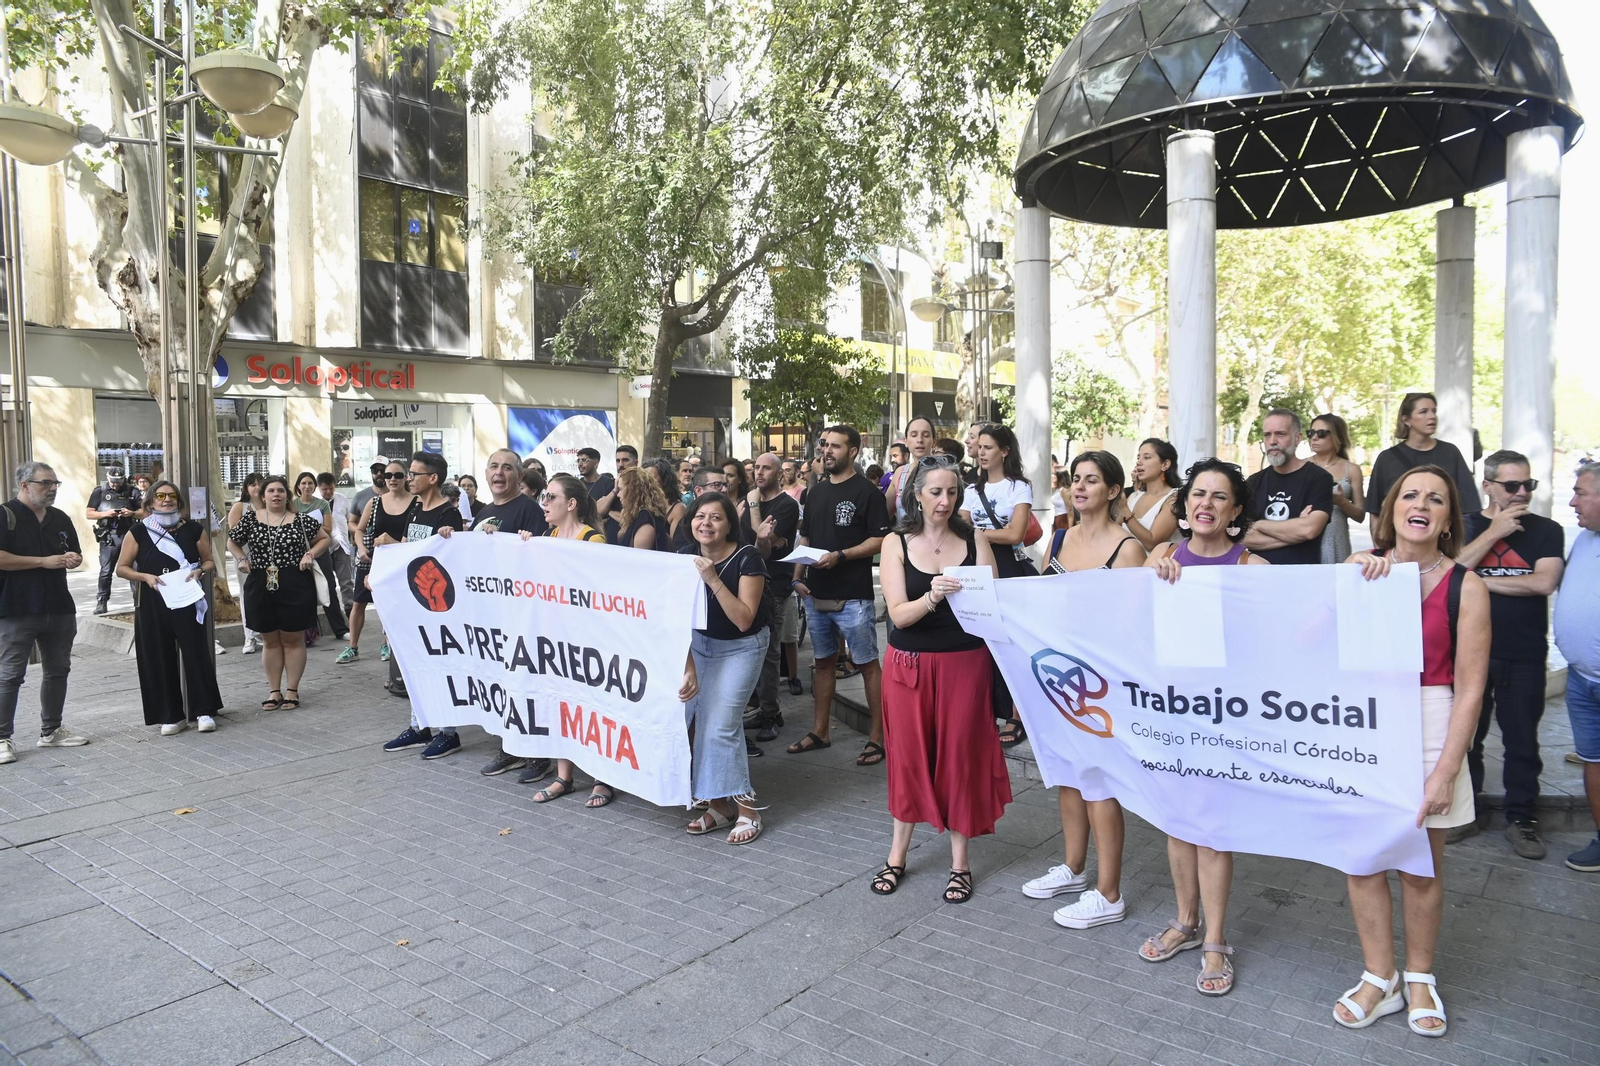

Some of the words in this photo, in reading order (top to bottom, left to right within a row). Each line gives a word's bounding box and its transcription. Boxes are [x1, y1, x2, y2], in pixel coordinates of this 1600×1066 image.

[247, 355, 415, 393] Soloptical
[354, 405, 397, 422] Soloptical
[554, 447, 579, 456] Soloptic
[560, 462, 578, 471] centr
[1479, 568, 1534, 576] KYNET
[418, 624, 465, 655] LA
[1122, 681, 1249, 724] Trabajo
[1260, 690, 1377, 729] Social
[559, 700, 640, 770] MATA
[1131, 722, 1185, 746] Colegio
[1190, 732, 1287, 754] Profesional
[1293, 741, 1378, 765] Córdoba
[1140, 758, 1253, 782] socialmente
[1259, 771, 1364, 798] esenciales
